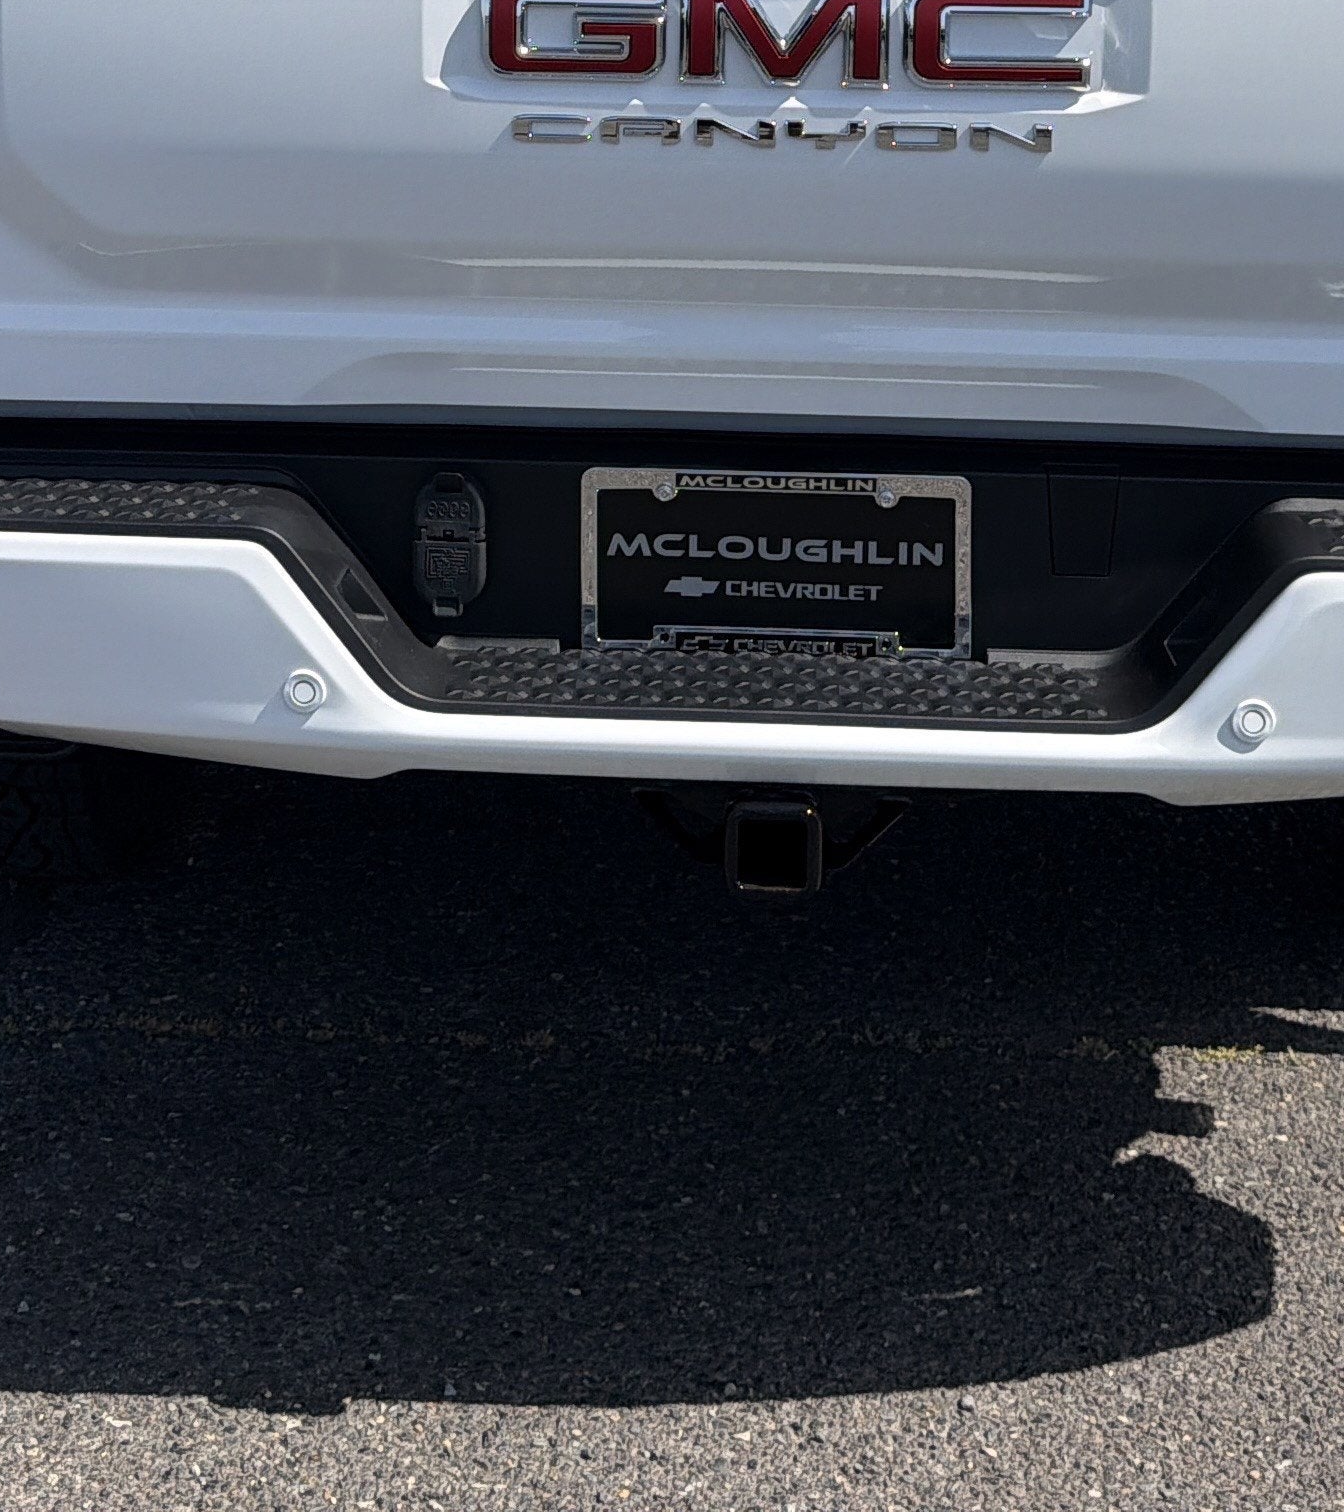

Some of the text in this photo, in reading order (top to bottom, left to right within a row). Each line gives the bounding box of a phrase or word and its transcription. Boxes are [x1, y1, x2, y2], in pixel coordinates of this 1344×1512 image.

[512, 114, 1053, 153] CANYON
[679, 474, 876, 492] MCLOUGHLIN
[606, 532, 944, 567] MCLOUGHLIN
[725, 580, 884, 602] CHEVROLET
[733, 638, 874, 658] CHEVROLET
